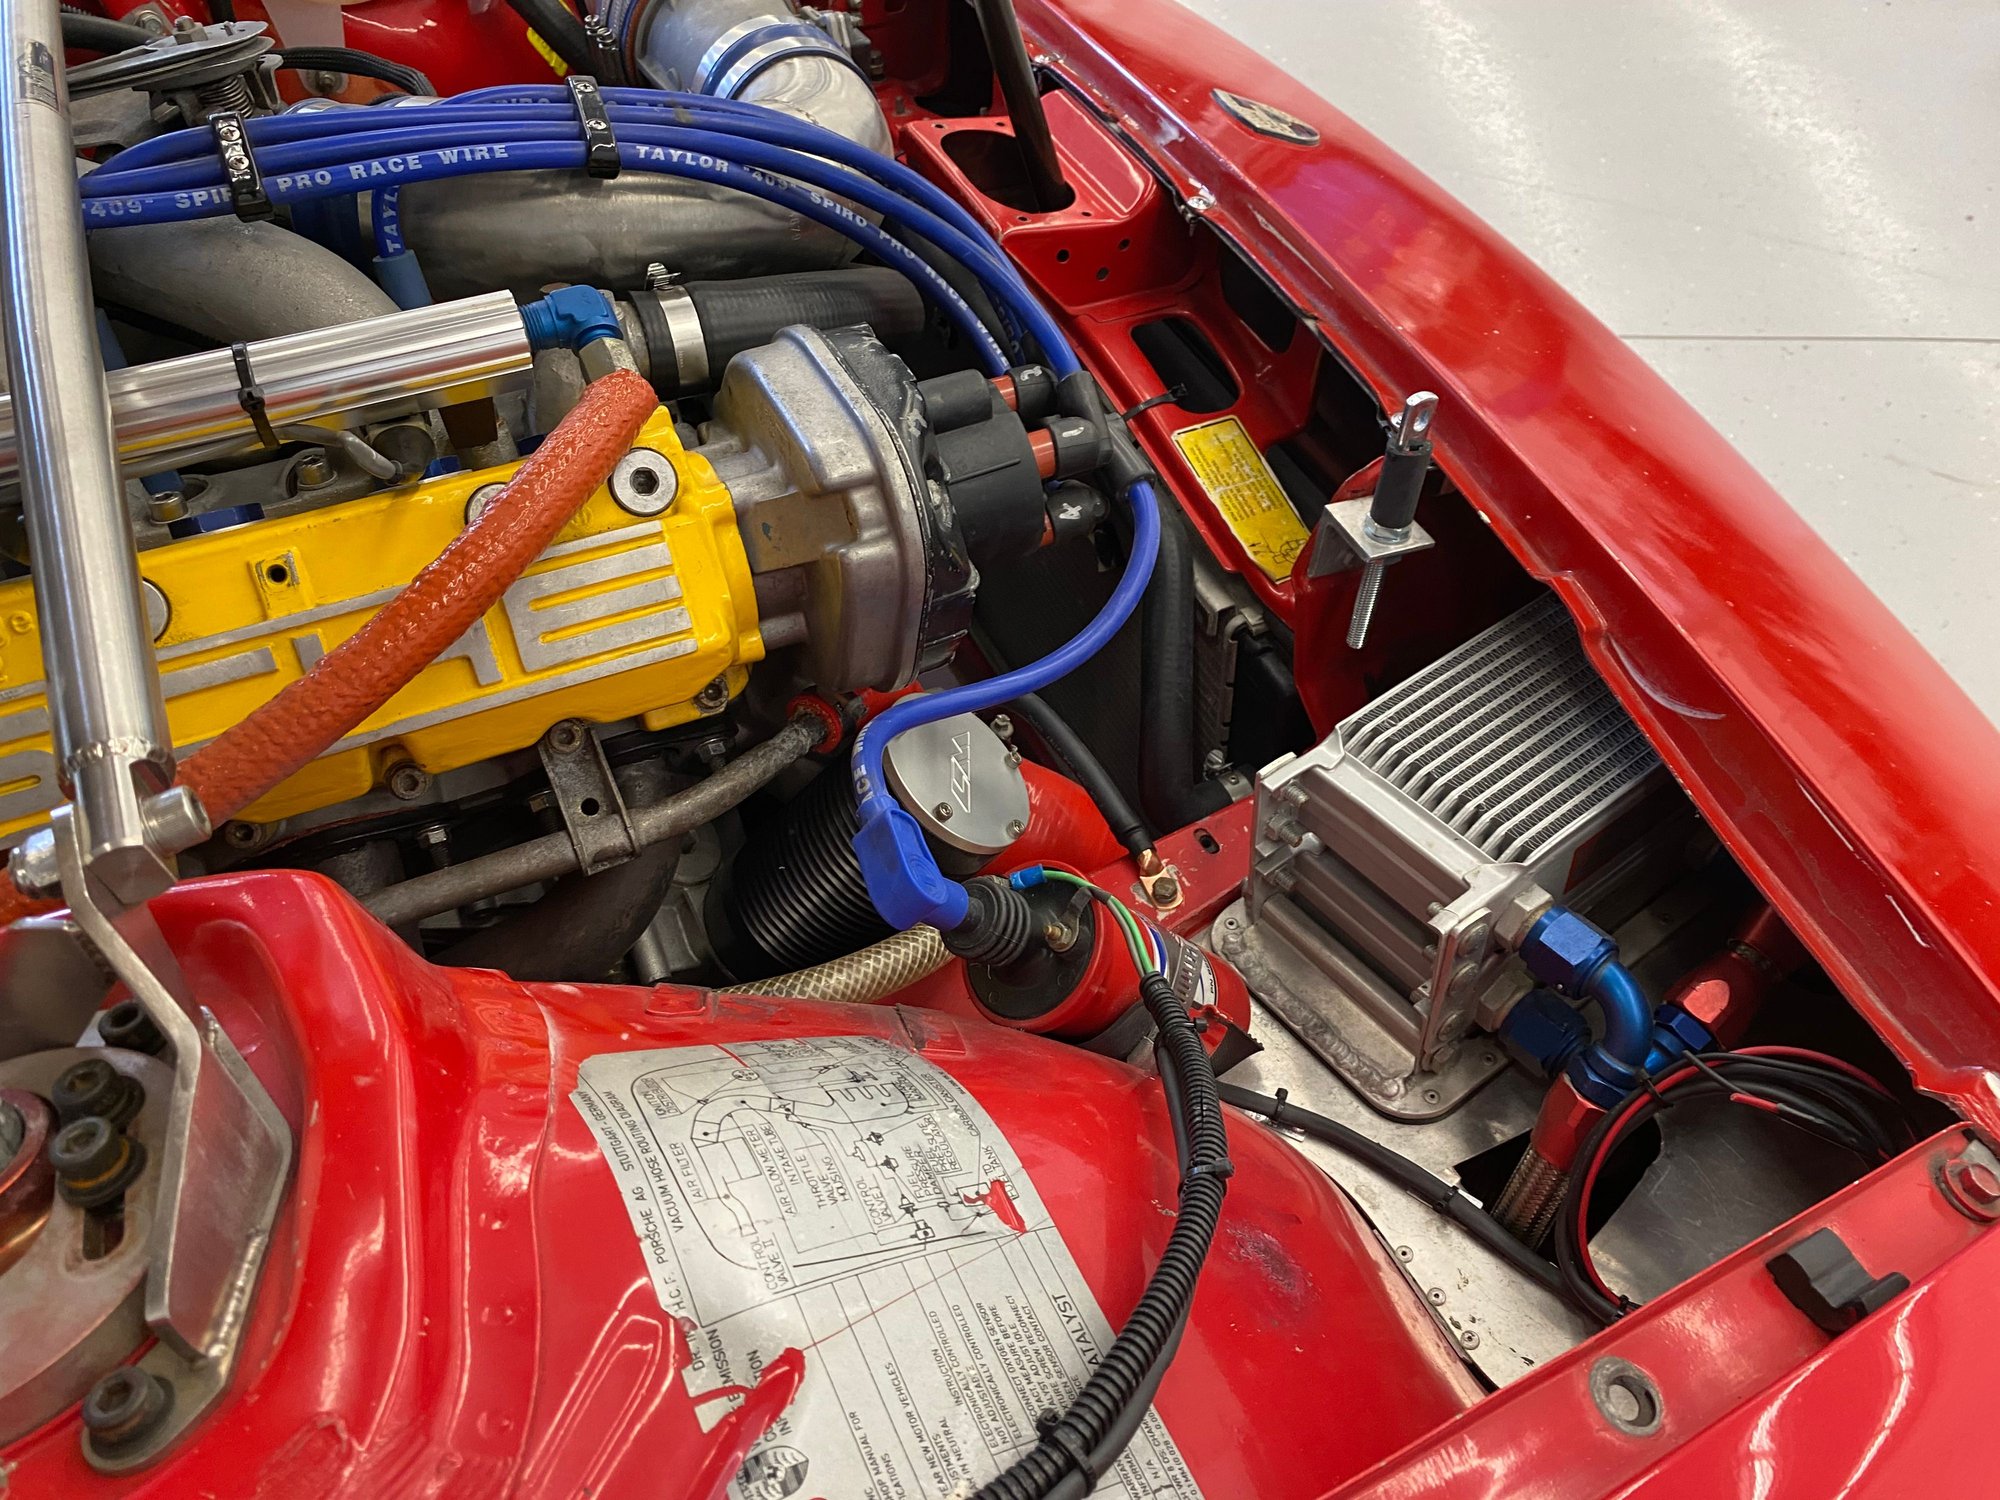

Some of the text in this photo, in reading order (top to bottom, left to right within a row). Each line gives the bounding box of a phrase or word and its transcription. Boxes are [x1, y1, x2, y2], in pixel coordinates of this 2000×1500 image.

[175, 188, 232, 209] SPIR
[276, 170, 332, 192] PRO
[350, 155, 423, 180] RACE
[437, 145, 509, 165] WIRE
[636, 145, 729, 173] TAYLOR
[809, 192, 868, 228] SPIRO
[1058, 502, 1083, 520] 4
[950, 1103, 979, 1137] CARBON
[602, 1089, 685, 1232] VACUUM HOSE ROUTING DIAGRAM
[758, 1122, 799, 1185] INTAKE TUBE
[923, 1114, 960, 1171] REGULATOR
[923, 1147, 942, 1174] FUEL
[981, 1144, 1003, 1171] TANK
[668, 1141, 703, 1198] AIR FILTER
[744, 1128, 796, 1215] AIR FLOW METER
[794, 1153, 828, 1209] THROTTLE
[817, 1173, 839, 1205] VALVE
[821, 1155, 850, 1202] HOUSING
[900, 1144, 934, 1197] PRESSURE
[905, 1170, 925, 1199] FUEL
[912, 1148, 942, 1195] DAMPER
[981, 1162, 995, 1175] TO
[631, 1185, 647, 1202] AG
[853, 1176, 884, 1225] CONTROL
[639, 1207, 669, 1264] PORSCHE
[746, 1234, 779, 1290] CONTROL
[767, 1251, 791, 1286] VALVE
[975, 1301, 998, 1336] SENSOR
[987, 1304, 1011, 1339] BEFORE
[1004, 1294, 1036, 1345] RECONNECT
[1007, 1322, 1023, 1342] IDLE
[1051, 1291, 1102, 1367] ATALYST
[930, 1347, 964, 1406] INSTRUCTION
[950, 1303, 1023, 1439] ELECTRONICALLY CONTROLLED
[992, 1337, 1017, 1373] OXYGEN
[1005, 1341, 1034, 1385] MEASURE
[1017, 1343, 1041, 1377] ADJUST
[1040, 1343, 1065, 1379] SENSOR
[882, 1361, 911, 1408] VEHICLES
[927, 1310, 999, 1448] ELECTRONICALLY CONTROLLED
[847, 1410, 863, 1431] FOR
[904, 1410, 927, 1443] MOTOR
[936, 1416, 964, 1461] NEUTRAL
[993, 1423, 1010, 1444] NOT
[857, 1432, 883, 1475] MANUAL
[919, 1444, 939, 1469] NEW
[958, 1463, 971, 1474] IN
